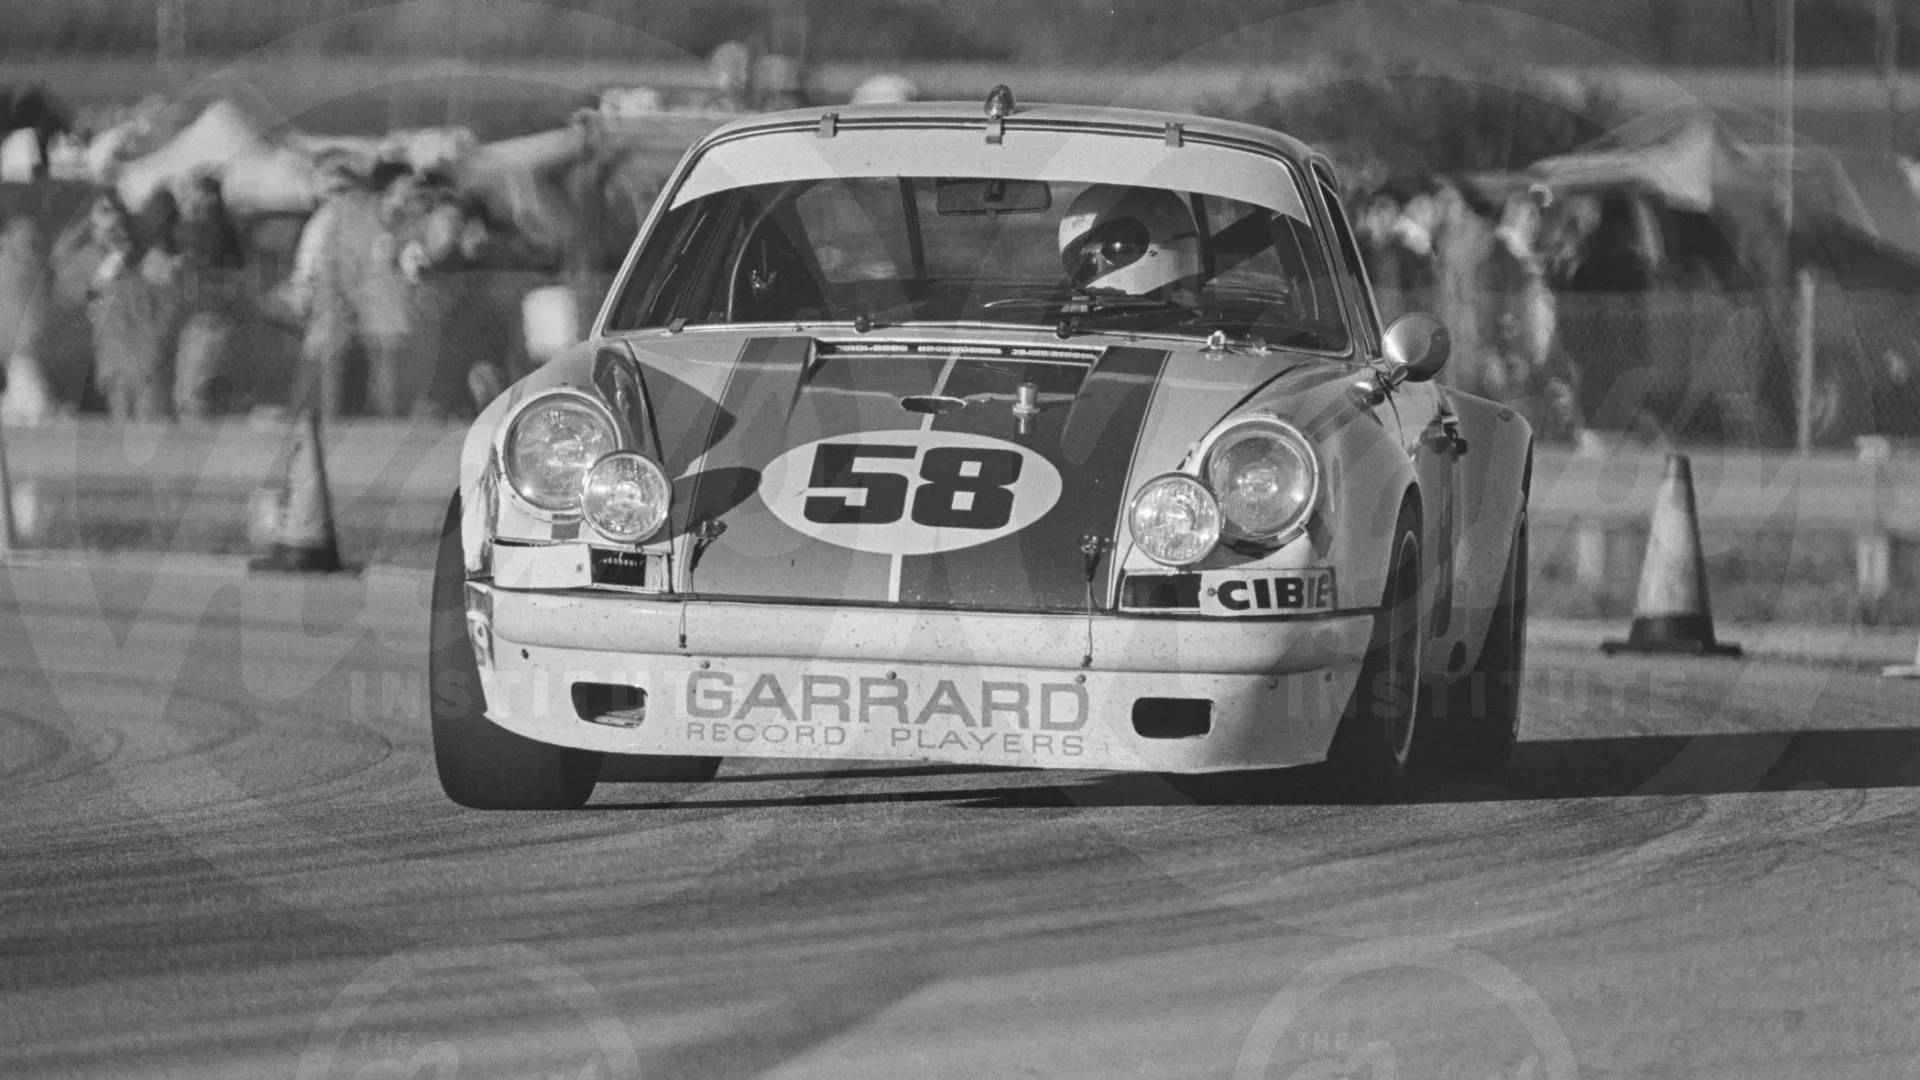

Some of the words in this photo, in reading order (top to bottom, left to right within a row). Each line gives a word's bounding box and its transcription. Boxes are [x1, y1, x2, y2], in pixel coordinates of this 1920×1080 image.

[804, 443, 1023, 529] 58
[686, 671, 1090, 731] GARRARD
[686, 722, 847, 746] RECORD
[891, 728, 1085, 757] PLAYERS
